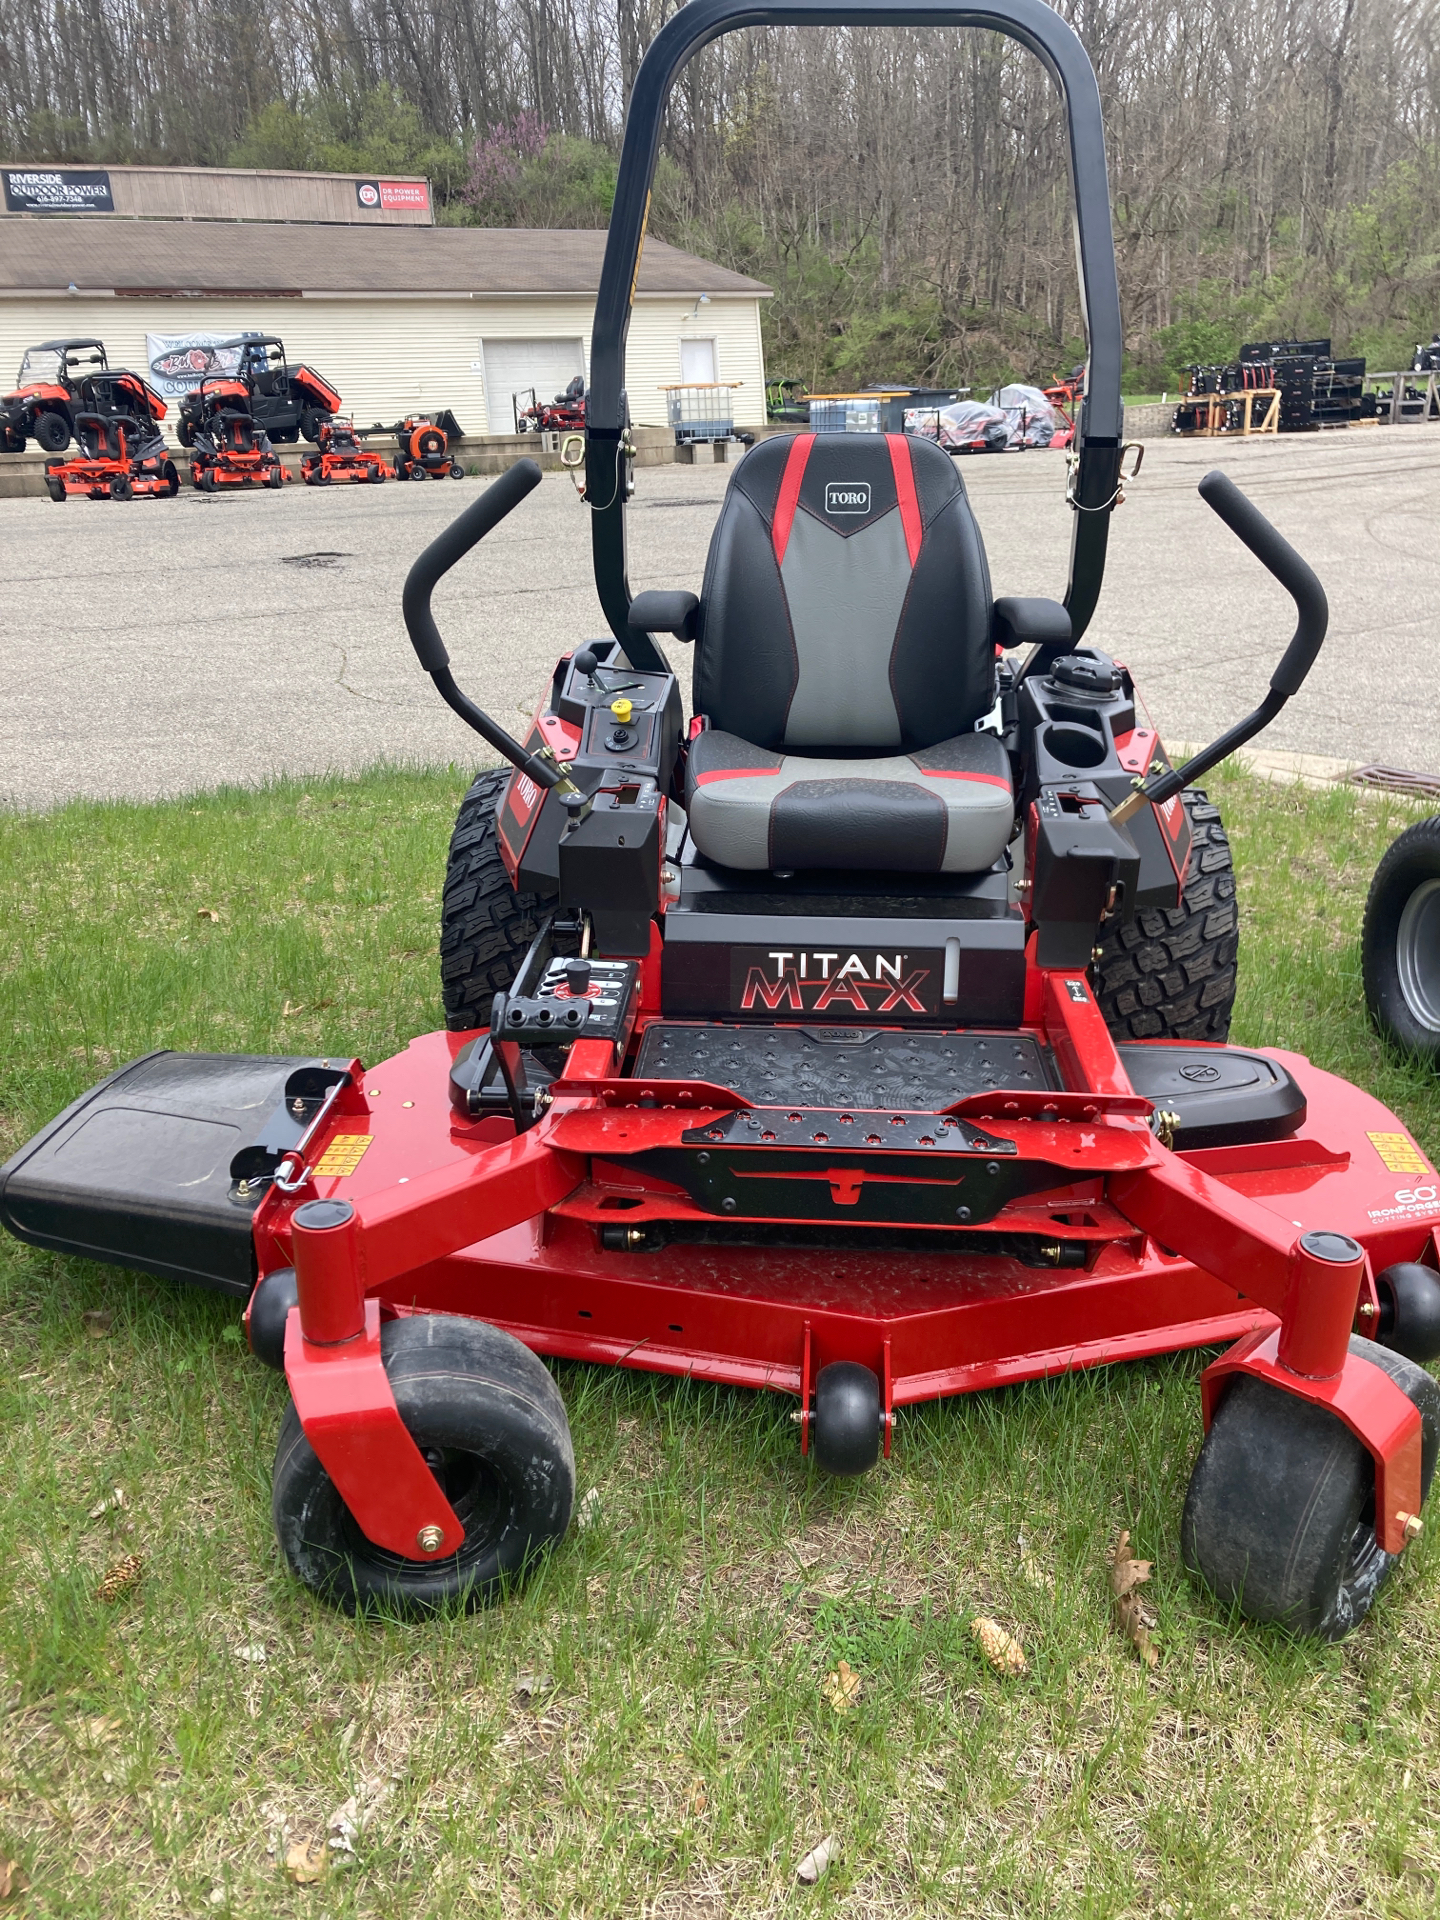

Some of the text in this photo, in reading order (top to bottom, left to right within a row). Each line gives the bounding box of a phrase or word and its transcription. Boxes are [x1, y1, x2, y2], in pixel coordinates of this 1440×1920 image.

[9, 174, 63, 184] RIVERSIDE
[11, 185, 106, 196] OUTDOOR POWER
[362, 191, 375, 199] DR
[829, 492, 867, 504] TORO
[768, 952, 903, 979] TITAN
[739, 966, 931, 1012] MAX
[1371, 1208, 1440, 1225] CUTTING SYST
